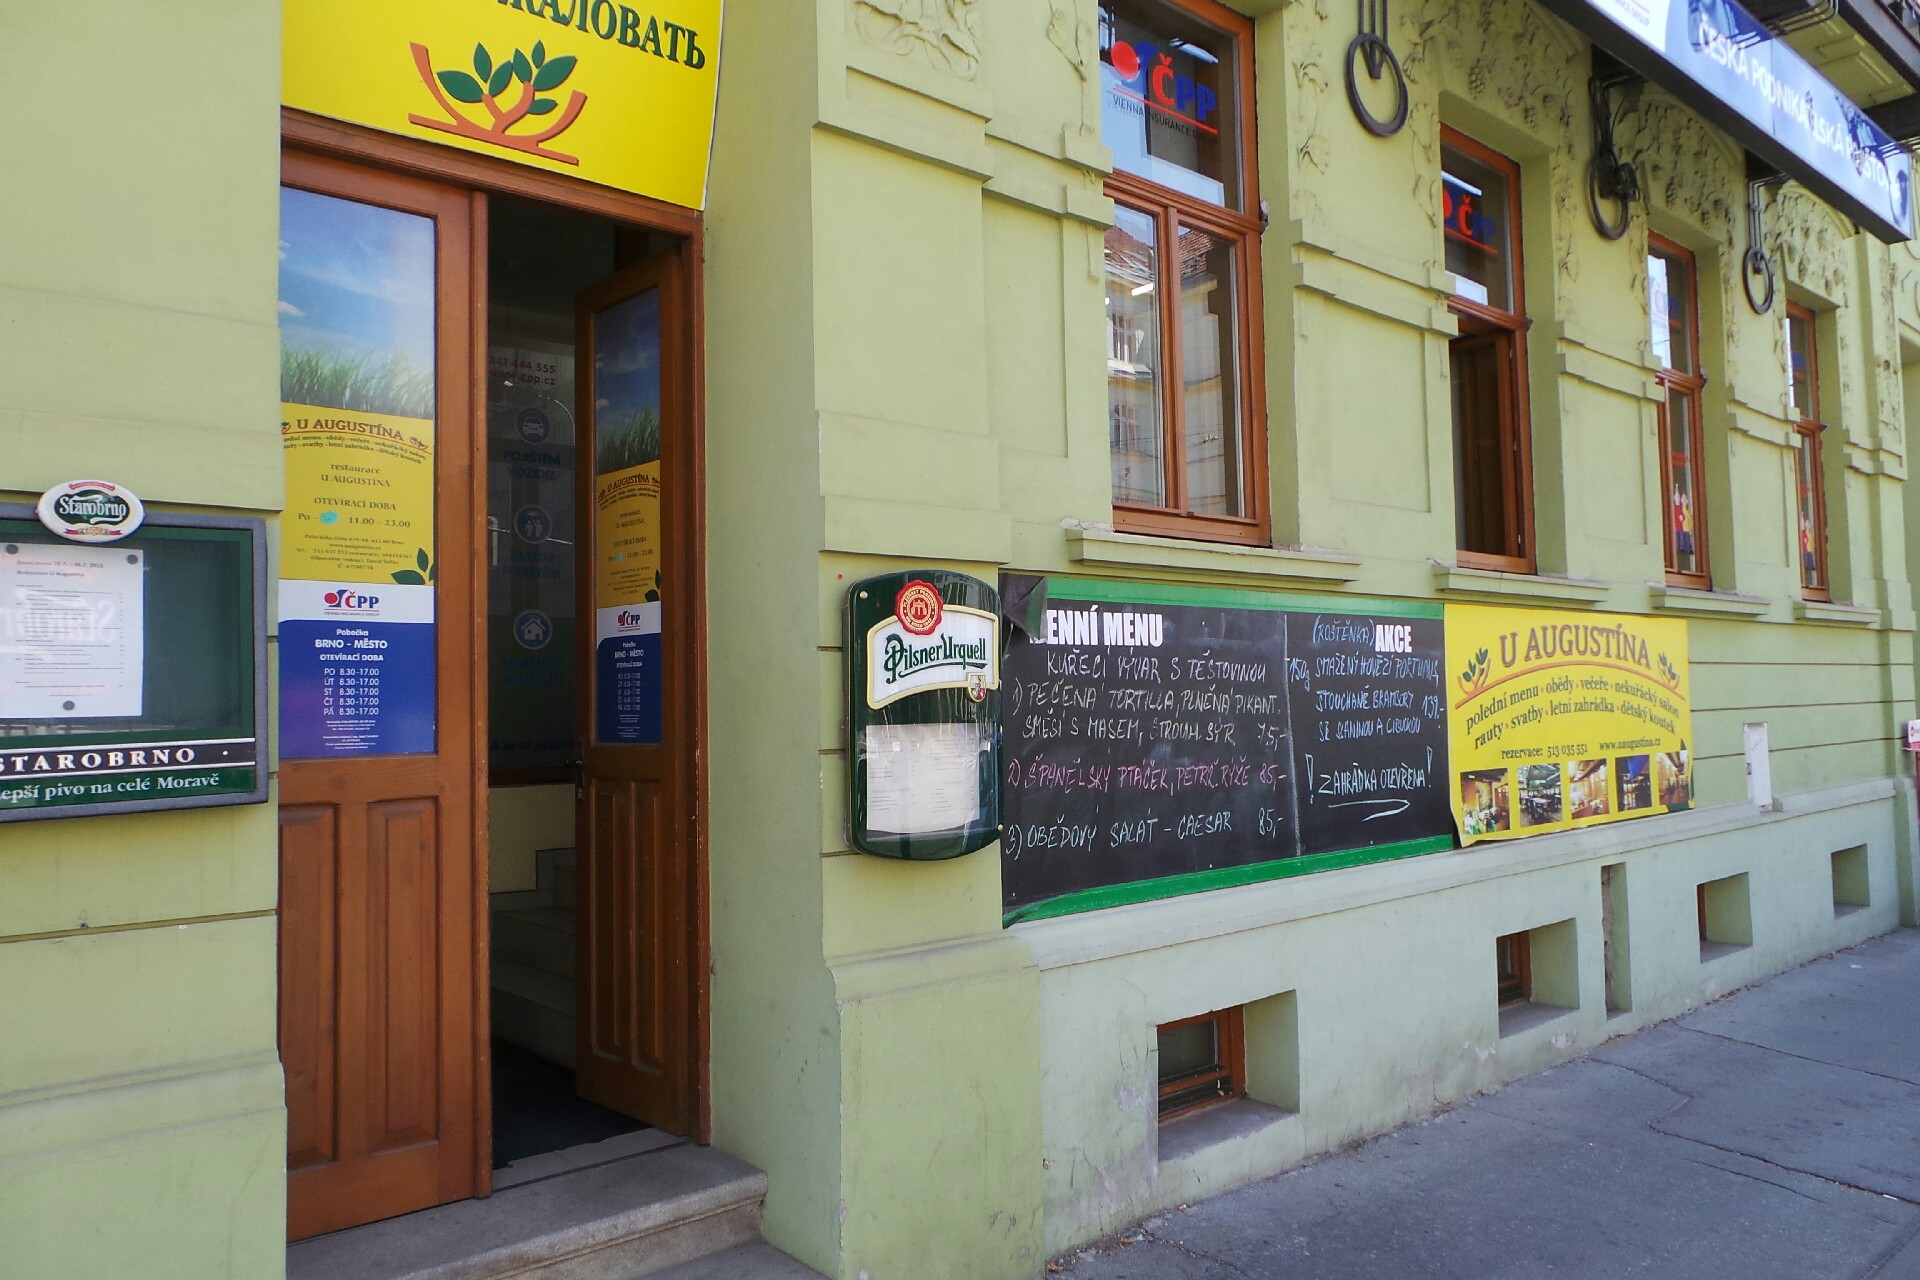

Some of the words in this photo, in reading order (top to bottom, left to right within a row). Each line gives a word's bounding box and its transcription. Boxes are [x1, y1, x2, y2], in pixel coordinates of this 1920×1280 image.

[1152, 52, 1217, 121] ČPP
[1113, 95, 1145, 116] VIENNA
[1150, 112, 1190, 136] NSURANCE
[537, 362, 556, 374] 555
[297, 418, 308, 430] U
[312, 419, 404, 442] AUGUSTÍNA
[321, 474, 329, 482] U
[330, 463, 381, 475] restaurace
[607, 483, 613, 492] U
[59, 495, 127, 523] Starobrno
[369, 501, 396, 511] DOBA
[298, 512, 310, 521] Po
[384, 518, 411, 528] 23.00
[344, 590, 379, 609] ČPP
[626, 612, 641, 626] ČPP
[1030, 605, 1098, 646] ENNÍ
[1104, 612, 1163, 647] MENU
[336, 628, 369, 636] Pobočka
[1375, 624, 1412, 652] AKCE
[315, 639, 344, 648] BRNO
[354, 637, 388, 649] MĚSTO
[1499, 631, 1518, 668] U
[1524, 623, 1652, 670] AUGUSTÍNA
[320, 652, 360, 661] OTEVÍRACÍ
[361, 653, 384, 661] DOBA
[884, 633, 942, 684] Pilsner
[940, 633, 986, 670] Urquell
[1047, 647, 1108, 677] KUŘECÍ
[1118, 646, 1161, 684] VÝVAR
[1171, 657, 1181, 681] S
[324, 668, 335, 676] PO
[324, 696, 334, 705] ČT
[1466, 691, 1508, 736] polední
[1510, 684, 1540, 705] menu
[1546, 675, 1575, 694] obědy
[1580, 675, 1609, 691] večeře
[1615, 679, 1658, 708] nekuřácký
[1659, 697, 1680, 719] salon
[324, 706, 334, 715] PÁ
[1071, 717, 1079, 736] S
[1377, 718, 1384, 735] A
[1475, 721, 1504, 750] rauty
[1511, 703, 1544, 730] svatby
[1550, 699, 1572, 716] letní
[1574, 694, 1615, 713] zahrádka
[1621, 699, 1647, 723] dětský
[1650, 709, 1676, 735] koutek
[1501, 747, 1543, 760] rezervace:
[1547, 746, 1560, 759] 513
[1561, 746, 1575, 757] 035
[1576, 744, 1588, 756] 551
[1599, 737, 1661, 751] www.uaugustina.cz
[1, 784, 40, 803] epší
[45, 783, 84, 801] pivo
[90, 784, 113, 794] na
[117, 778, 150, 792] celé
[157, 773, 220, 790] Moravě
[1110, 808, 1158, 848] SALÁT
[1178, 811, 1232, 839] CAESAR
